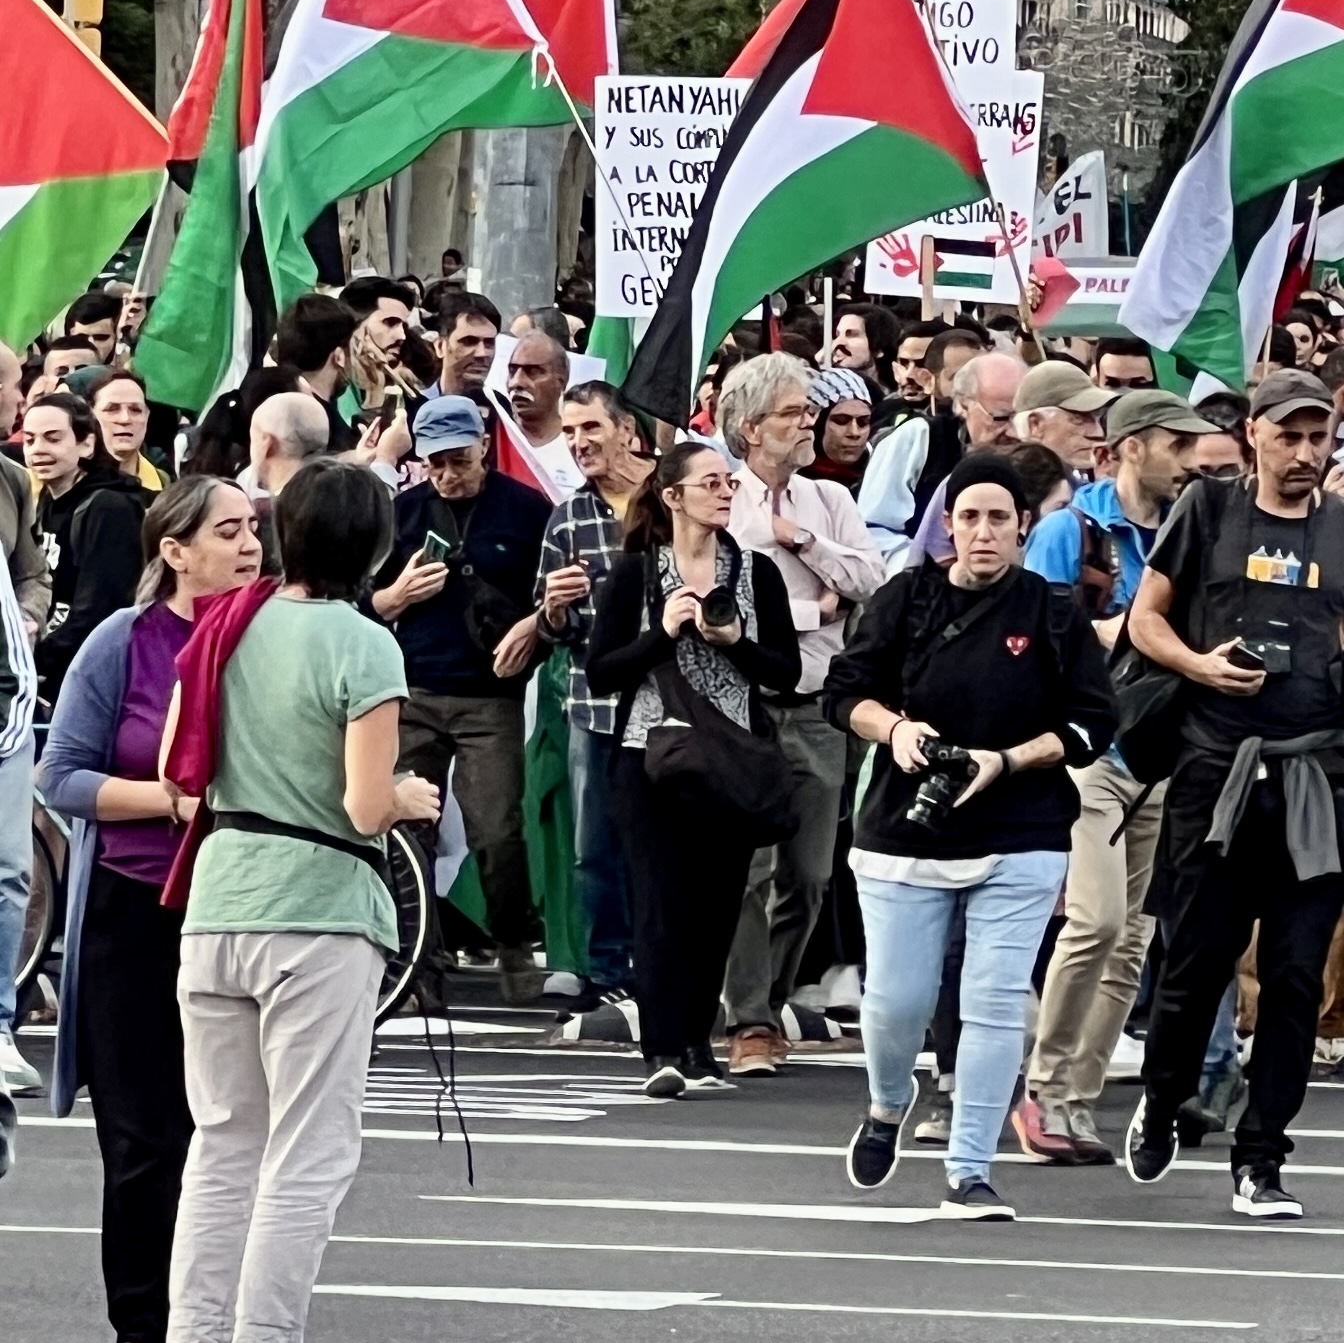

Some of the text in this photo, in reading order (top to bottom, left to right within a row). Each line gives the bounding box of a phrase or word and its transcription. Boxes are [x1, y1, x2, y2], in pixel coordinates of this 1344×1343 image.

[605, 125, 616, 149] Y
[630, 126, 664, 148] SUS
[609, 160, 716, 184] A LA CORT
